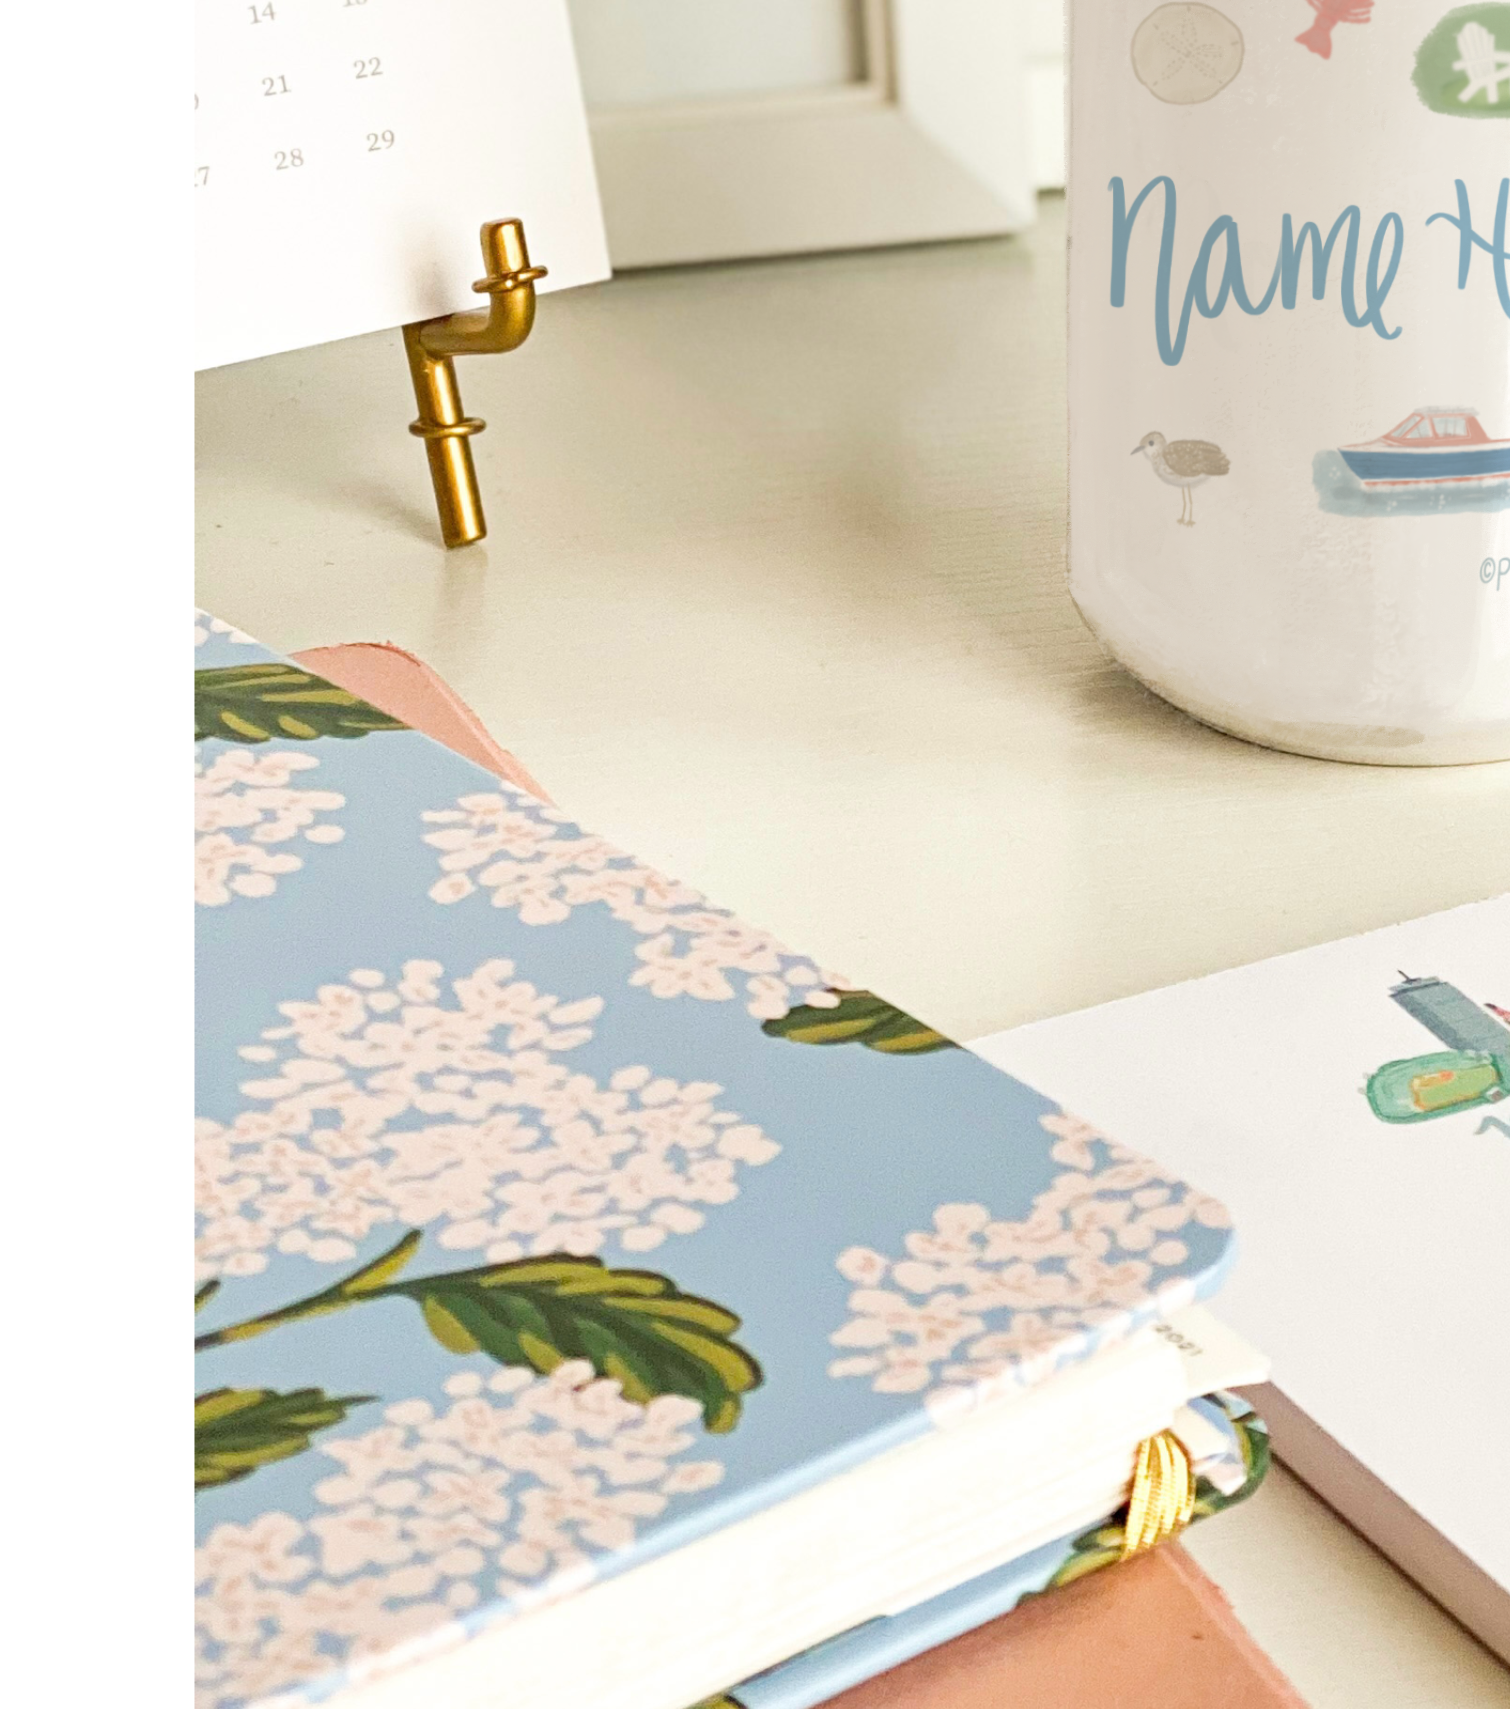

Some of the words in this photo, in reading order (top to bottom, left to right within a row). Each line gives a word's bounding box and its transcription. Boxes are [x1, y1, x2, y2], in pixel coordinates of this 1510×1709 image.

[248, 2, 277, 25] 14
[261, 74, 292, 96] 21
[353, 56, 384, 79] 22
[274, 148, 304, 171] 28
[366, 129, 396, 152] 29
[1107, 175, 1403, 366] Name
